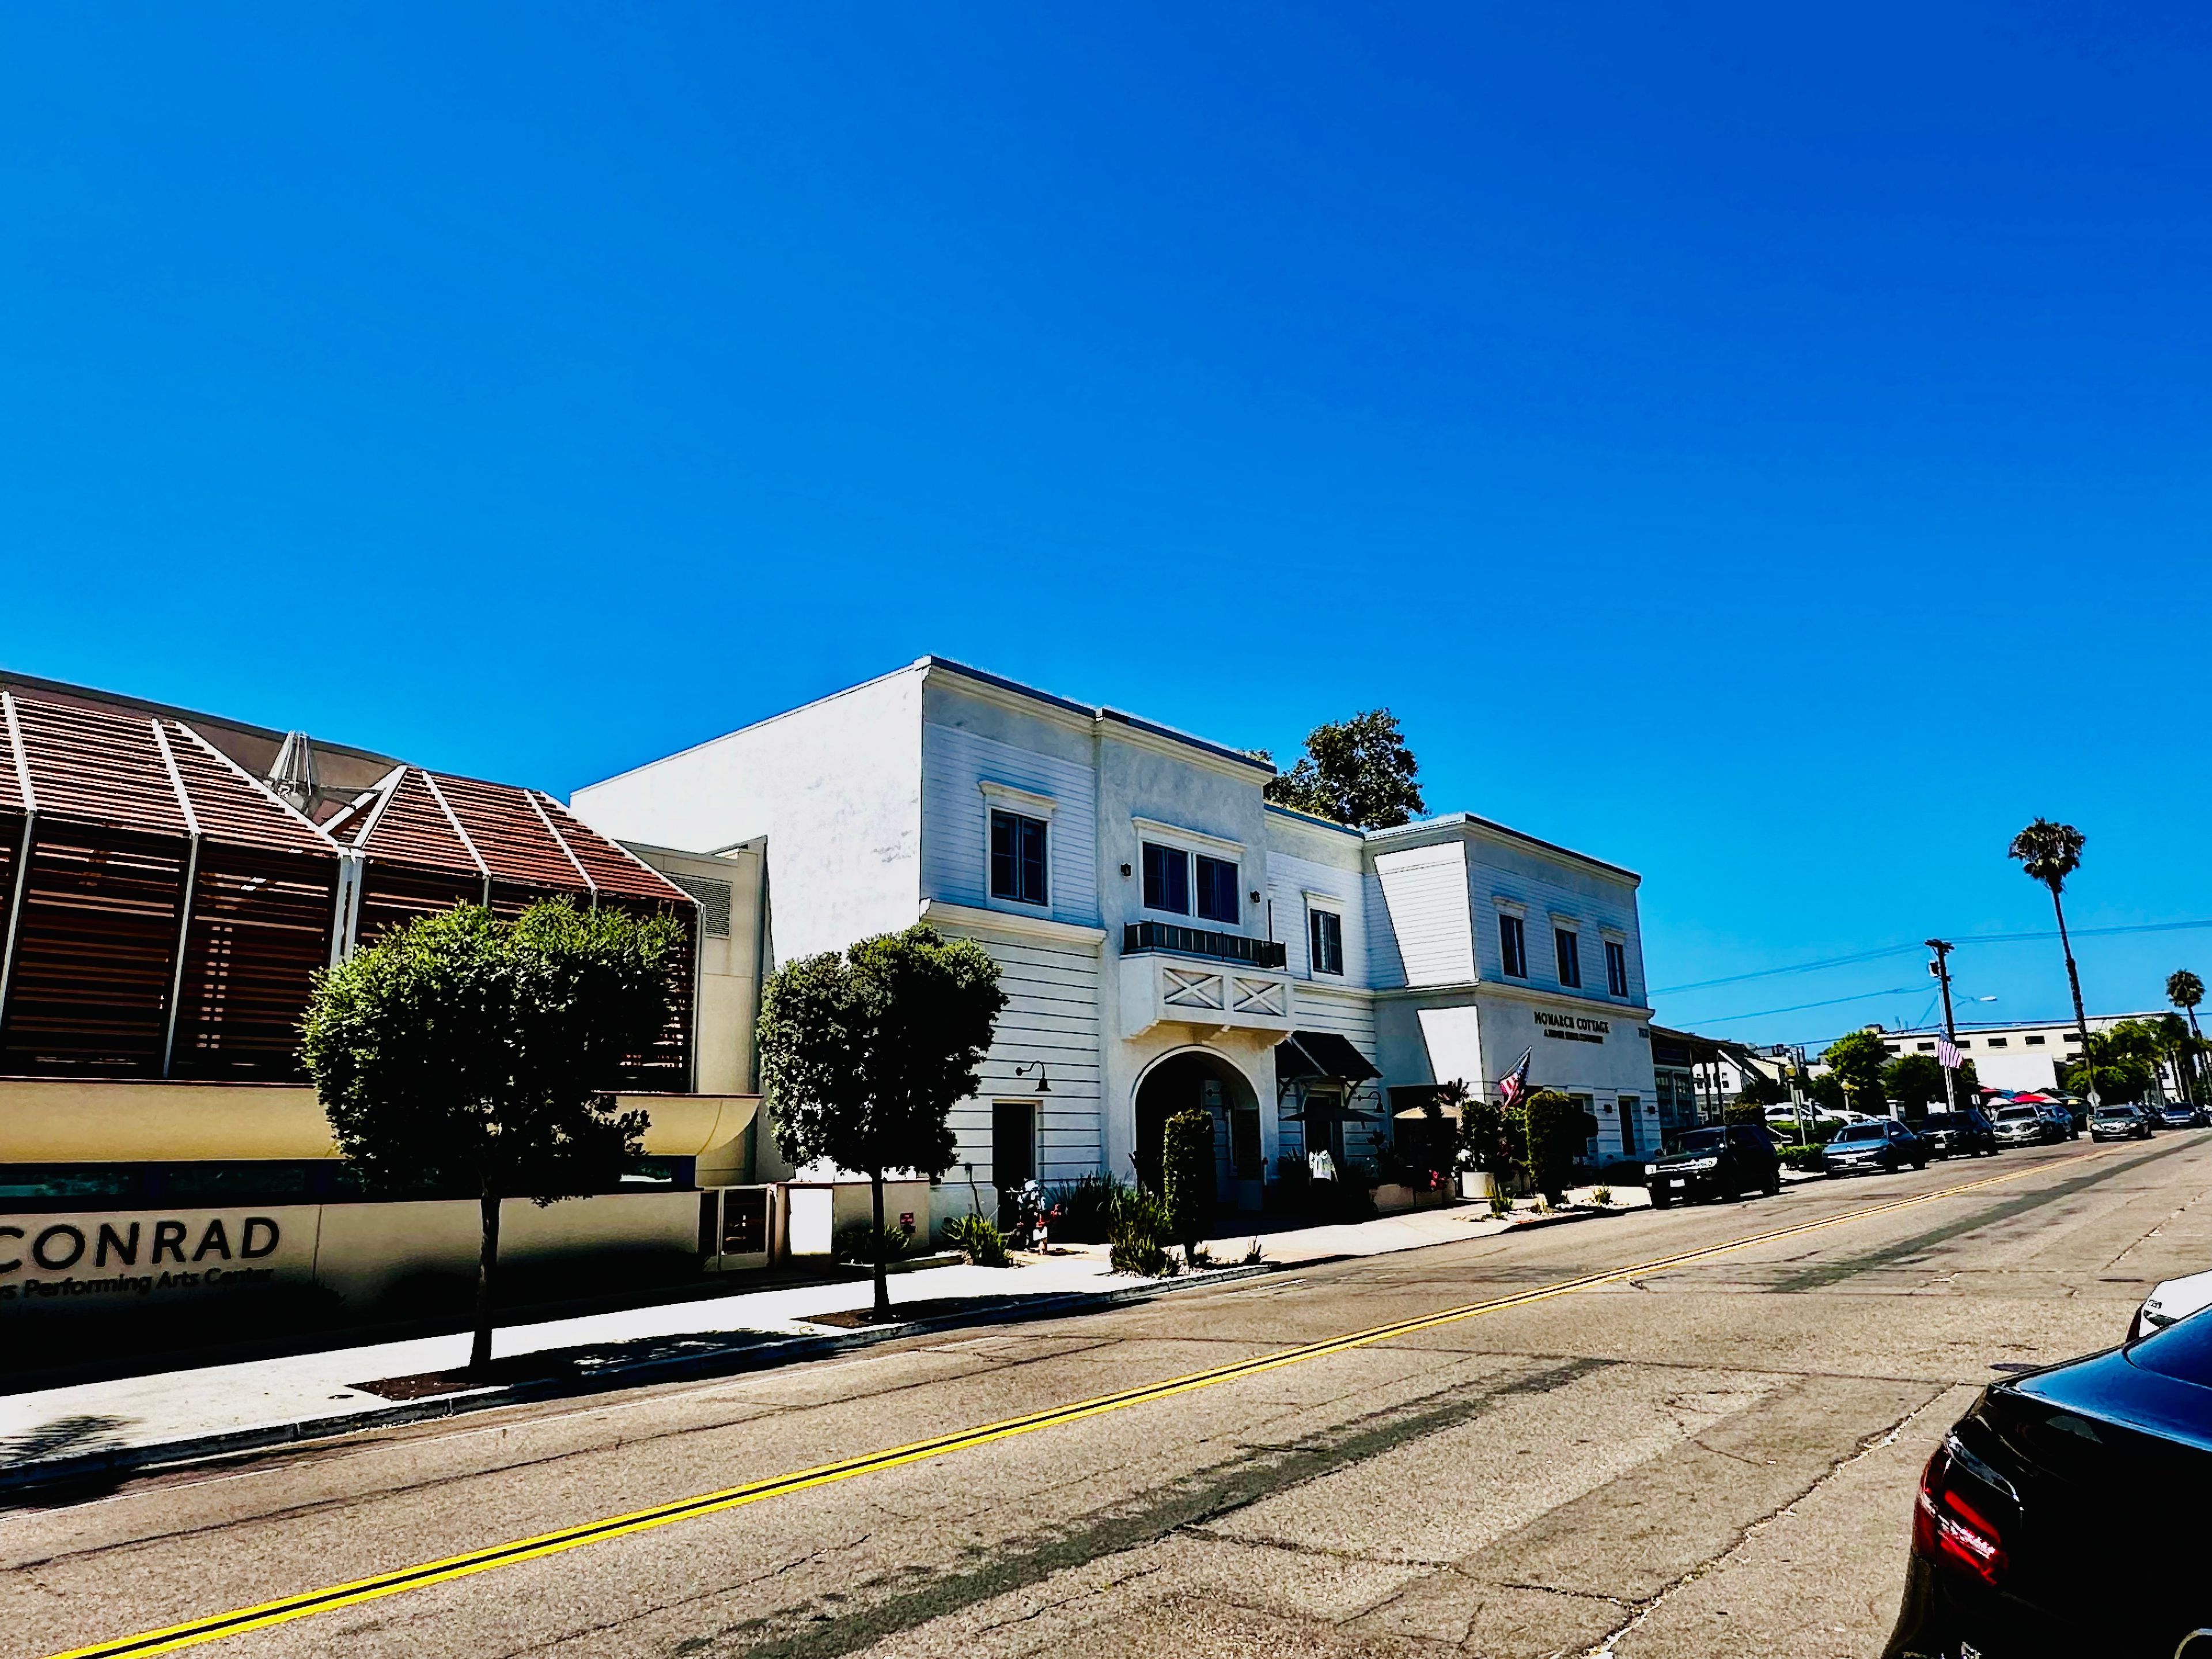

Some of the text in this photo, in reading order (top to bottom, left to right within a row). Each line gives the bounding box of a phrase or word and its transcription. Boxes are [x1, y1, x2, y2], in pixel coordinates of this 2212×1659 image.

[1577, 1017, 1609, 1033] COTTAGE
[24, 1274, 152, 1298] Performing
[156, 1271, 200, 1289] Arts
[204, 1267, 274, 1285] Center
